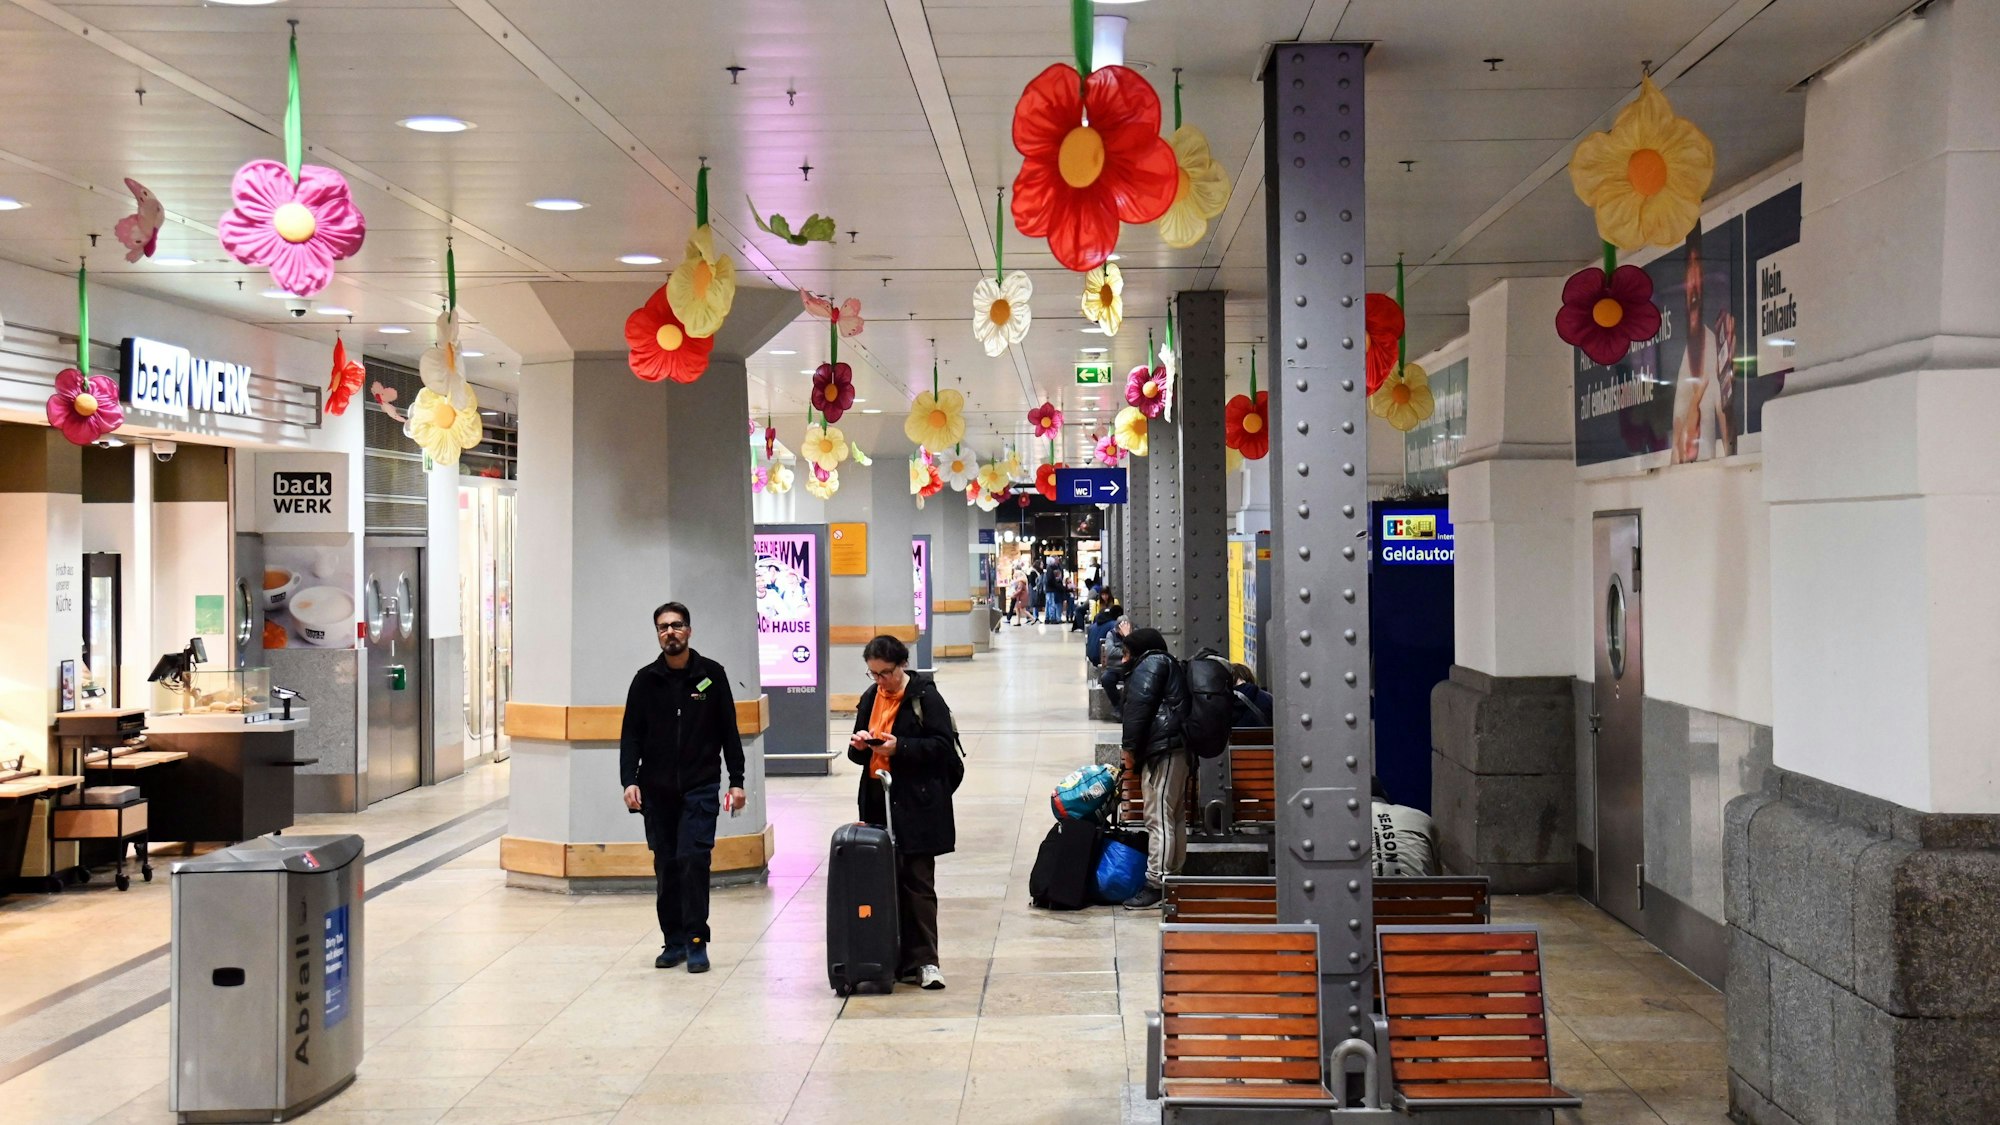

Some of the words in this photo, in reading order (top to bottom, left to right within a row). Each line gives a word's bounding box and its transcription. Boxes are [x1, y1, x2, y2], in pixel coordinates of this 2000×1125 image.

[1762, 293, 1797, 336] Einkaufs
[137, 346, 184, 407] back
[190, 357, 253, 416] WERK
[1580, 384, 1591, 420] auf
[276, 474, 329, 494] back
[1075, 487, 1089, 496] WC
[273, 499, 332, 513] WERK
[779, 541, 810, 580] WM
[772, 621, 811, 633] HAUSE
[1377, 813, 1399, 863] SEASON
[295, 934, 310, 1066] Abfall
